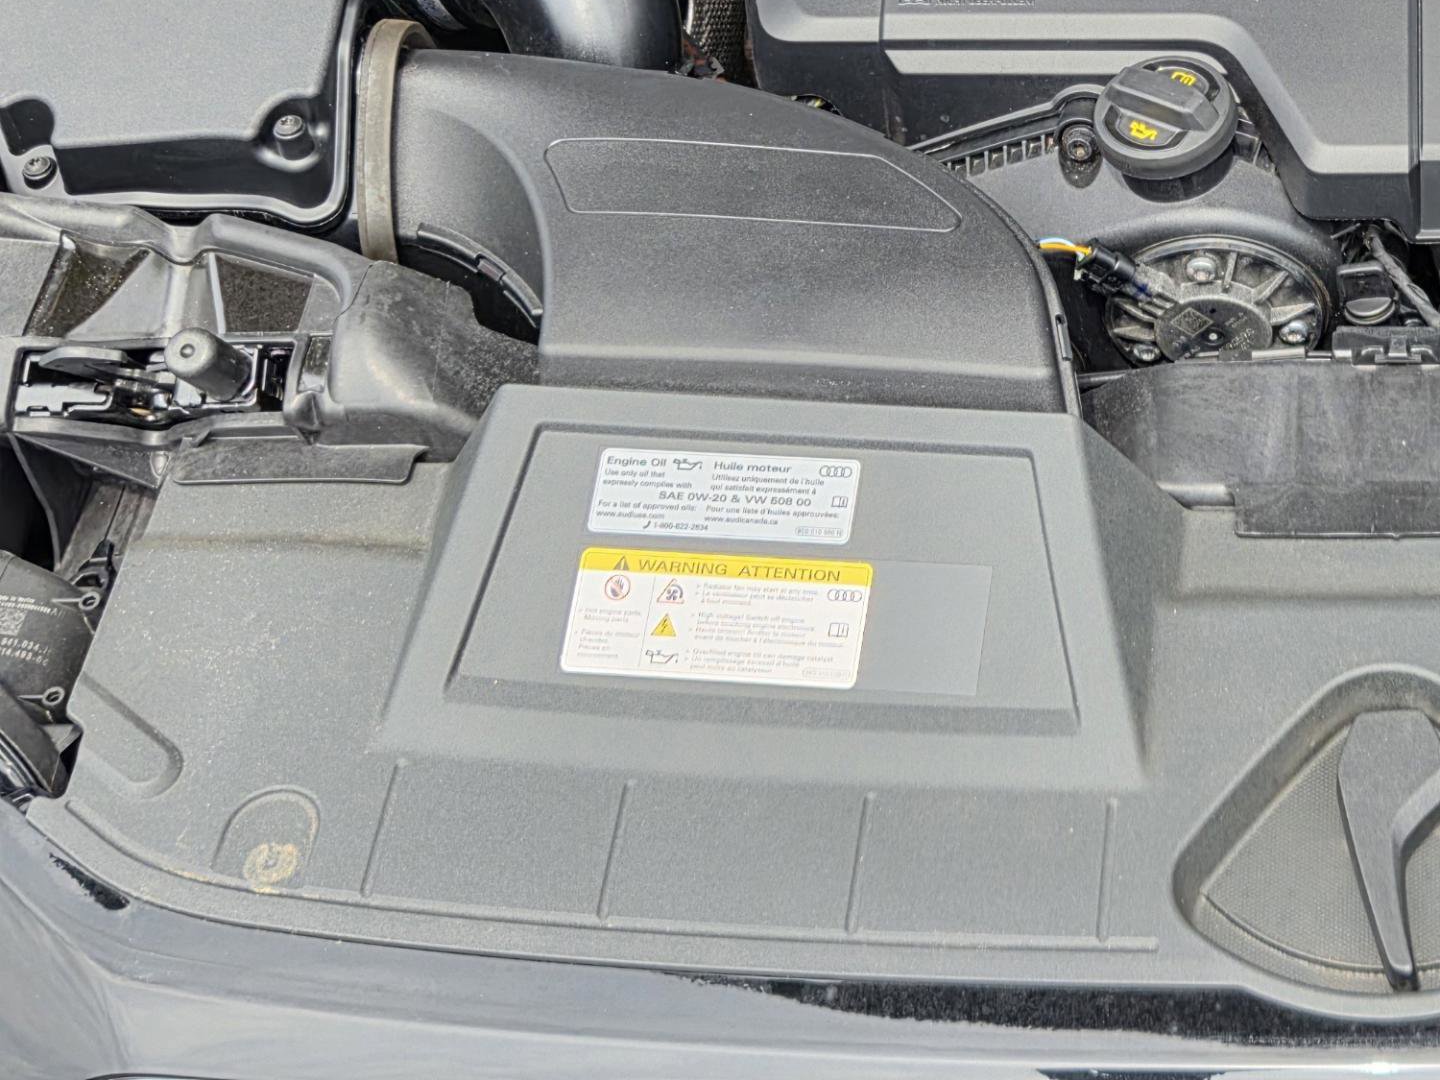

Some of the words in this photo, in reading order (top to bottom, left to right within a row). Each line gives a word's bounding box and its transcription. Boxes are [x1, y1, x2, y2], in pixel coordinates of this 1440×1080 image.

[607, 456, 647, 467] Engine
[651, 457, 667, 467] Oil
[713, 461, 743, 471] Huile
[747, 463, 792, 473] moteur
[650, 470, 665, 478] that
[658, 490, 684, 500] SAE
[687, 492, 727, 503] 0W-20
[731, 495, 740, 503] &
[745, 495, 768, 504] VW
[770, 496, 793, 506] 508
[796, 497, 812, 507] 00
[638, 559, 728, 575] WARNING
[738, 565, 841, 582] ATTENTION
